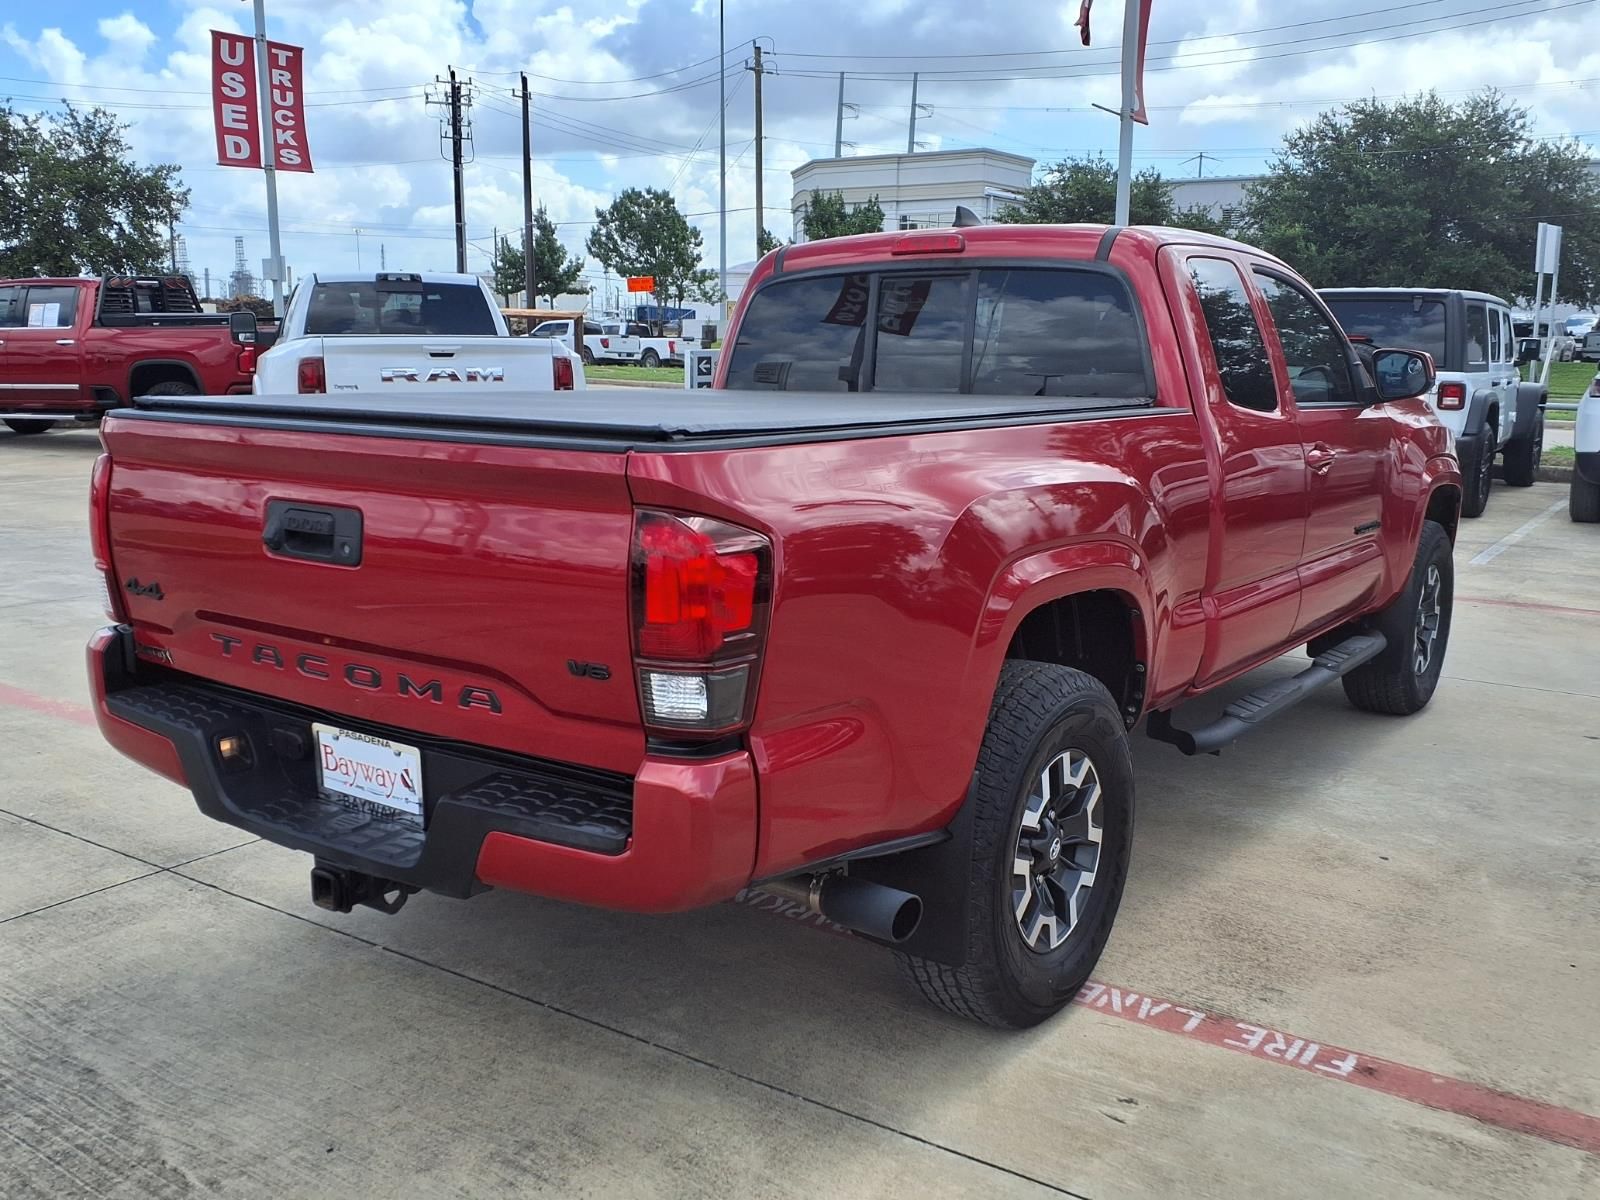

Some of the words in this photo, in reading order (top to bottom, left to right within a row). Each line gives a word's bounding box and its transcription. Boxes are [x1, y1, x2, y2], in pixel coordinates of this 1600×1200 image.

[220, 38, 251, 160] USED
[271, 48, 302, 165] TRUCKS
[380, 366, 505, 383] RAM
[209, 632, 503, 716] TACOMA
[567, 658, 611, 681] V6
[338, 728, 392, 749] PASADENA
[321, 743, 397, 799] Bayway
[1075, 982, 1206, 1032] LANE
[1223, 1022, 1358, 1077] FIRE
